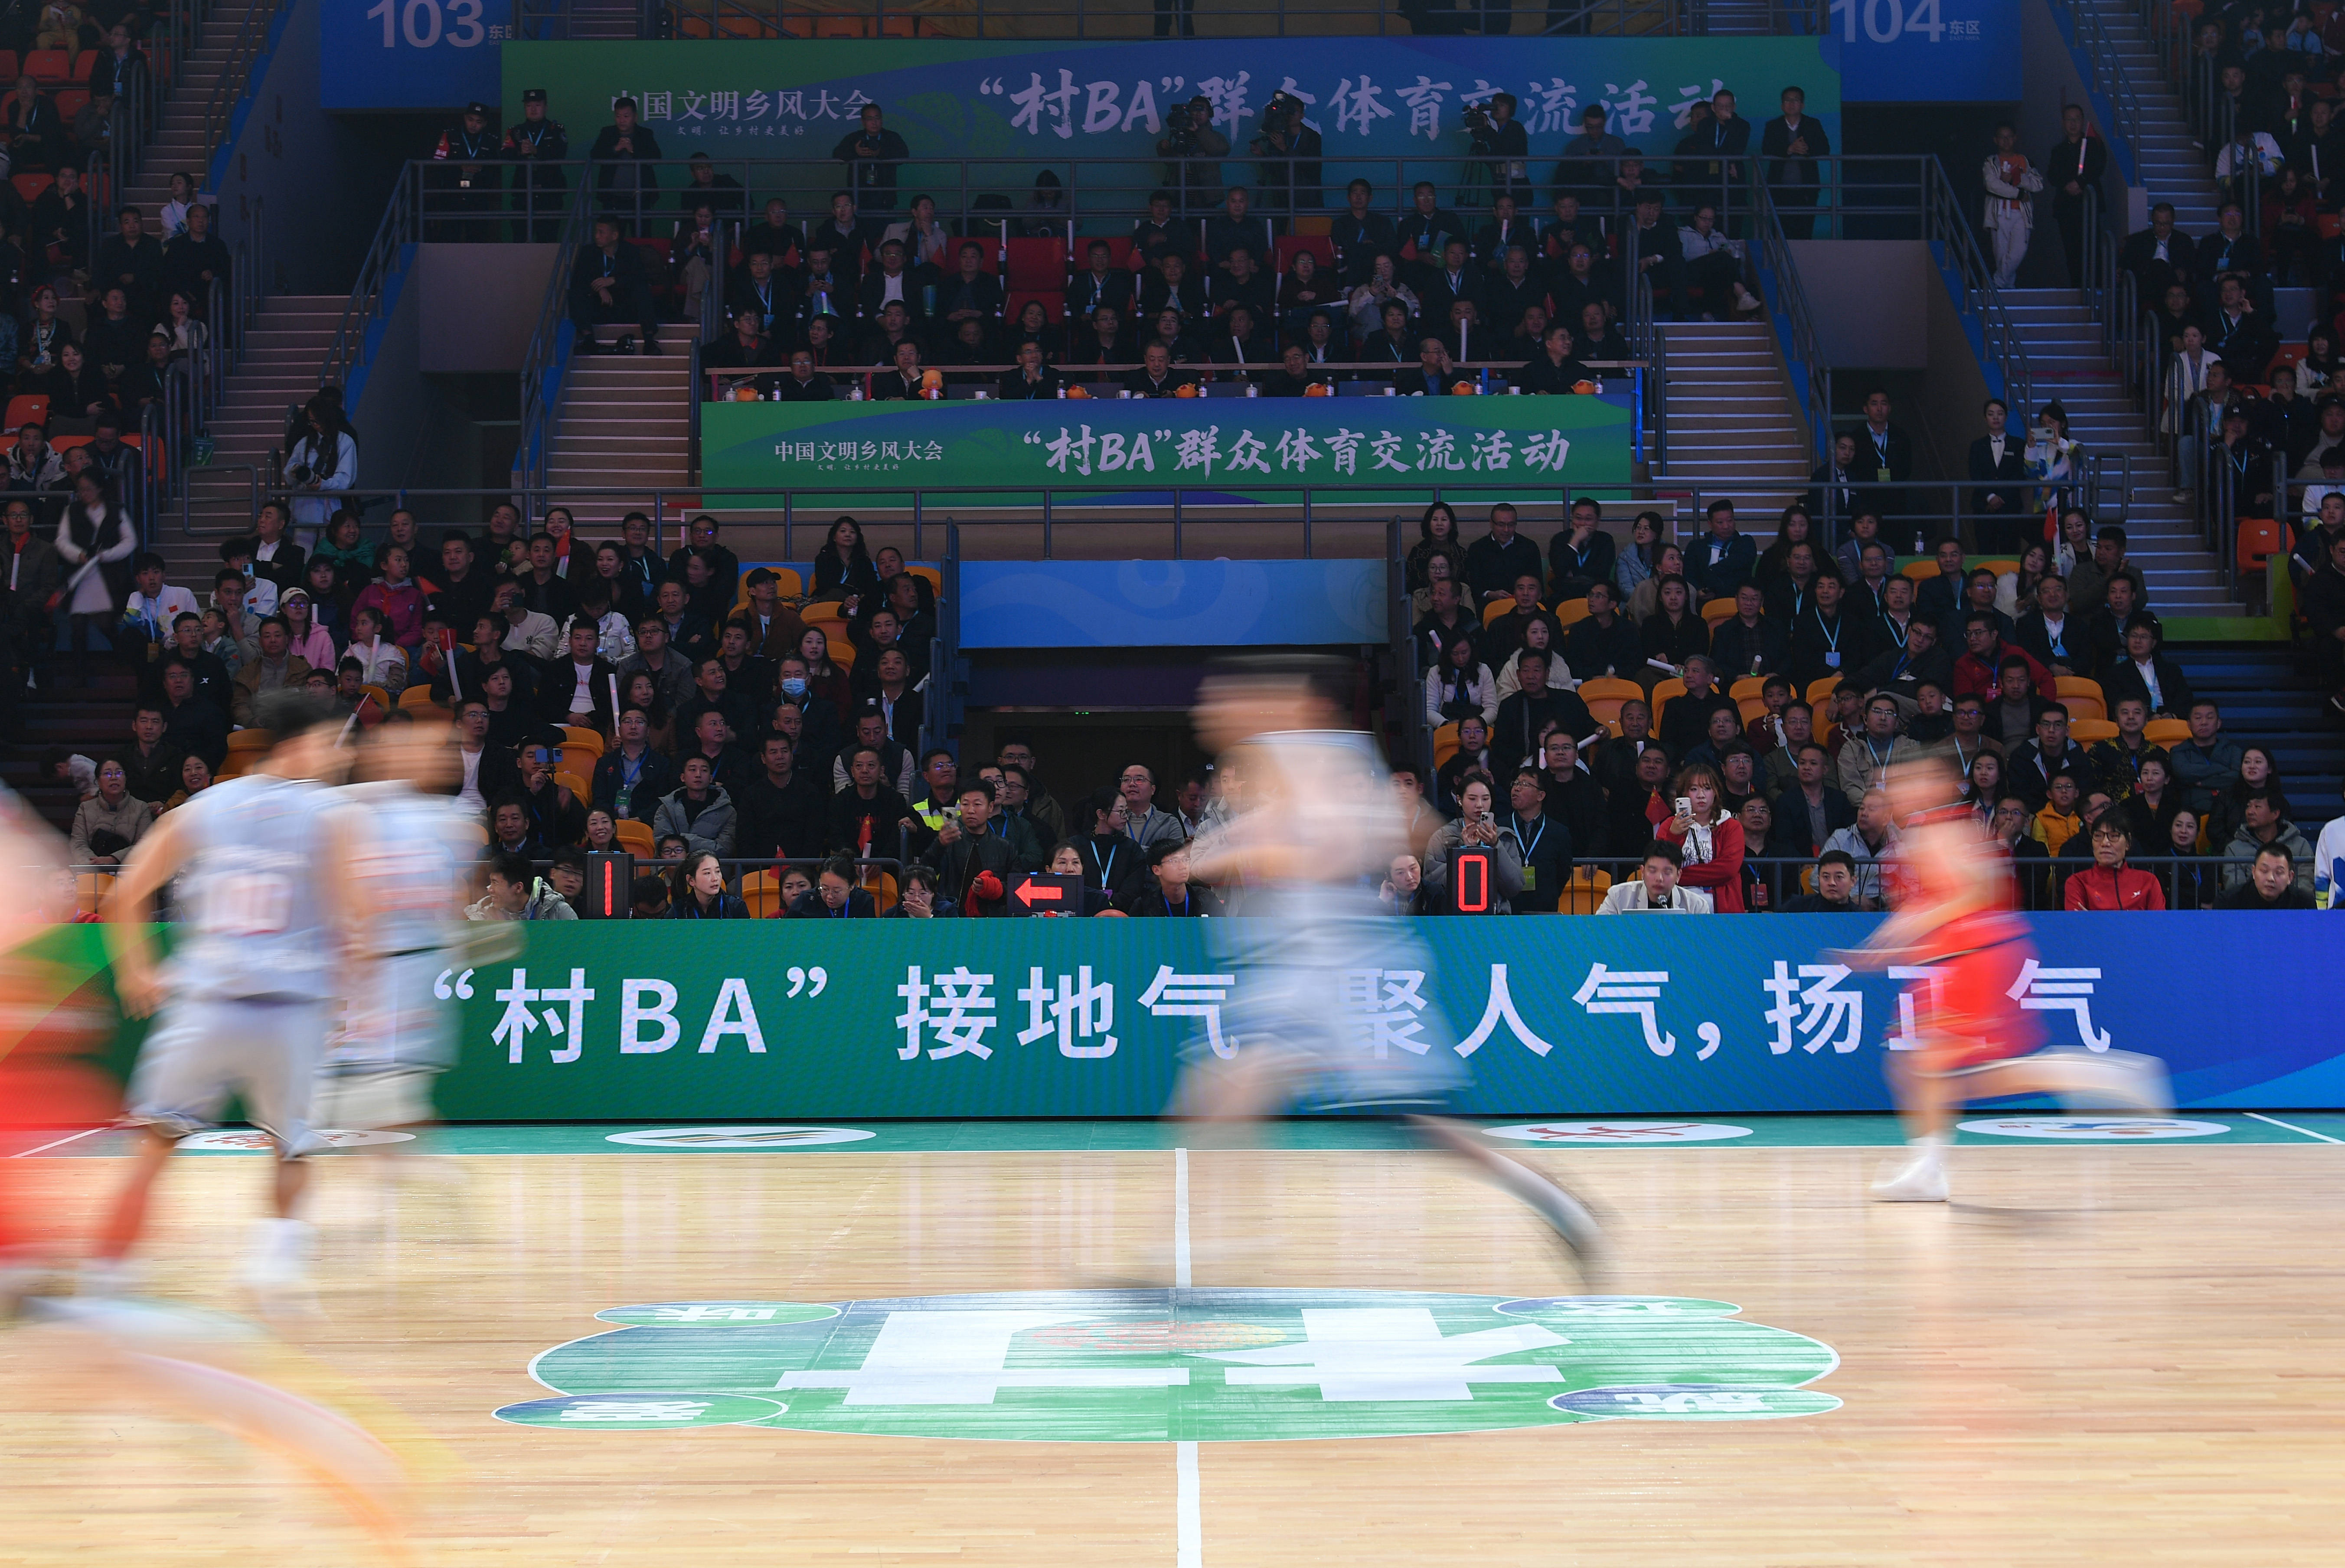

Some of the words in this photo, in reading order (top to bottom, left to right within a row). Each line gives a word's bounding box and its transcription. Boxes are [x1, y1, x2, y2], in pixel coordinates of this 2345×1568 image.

[367, 0, 485, 48] 103
[1830, 0, 1946, 43] 104
[1950, 20, 1980, 35] 东区
[775, 440, 943, 461] 中国文明乡风大会
[1457, 854, 1488, 912] 0
